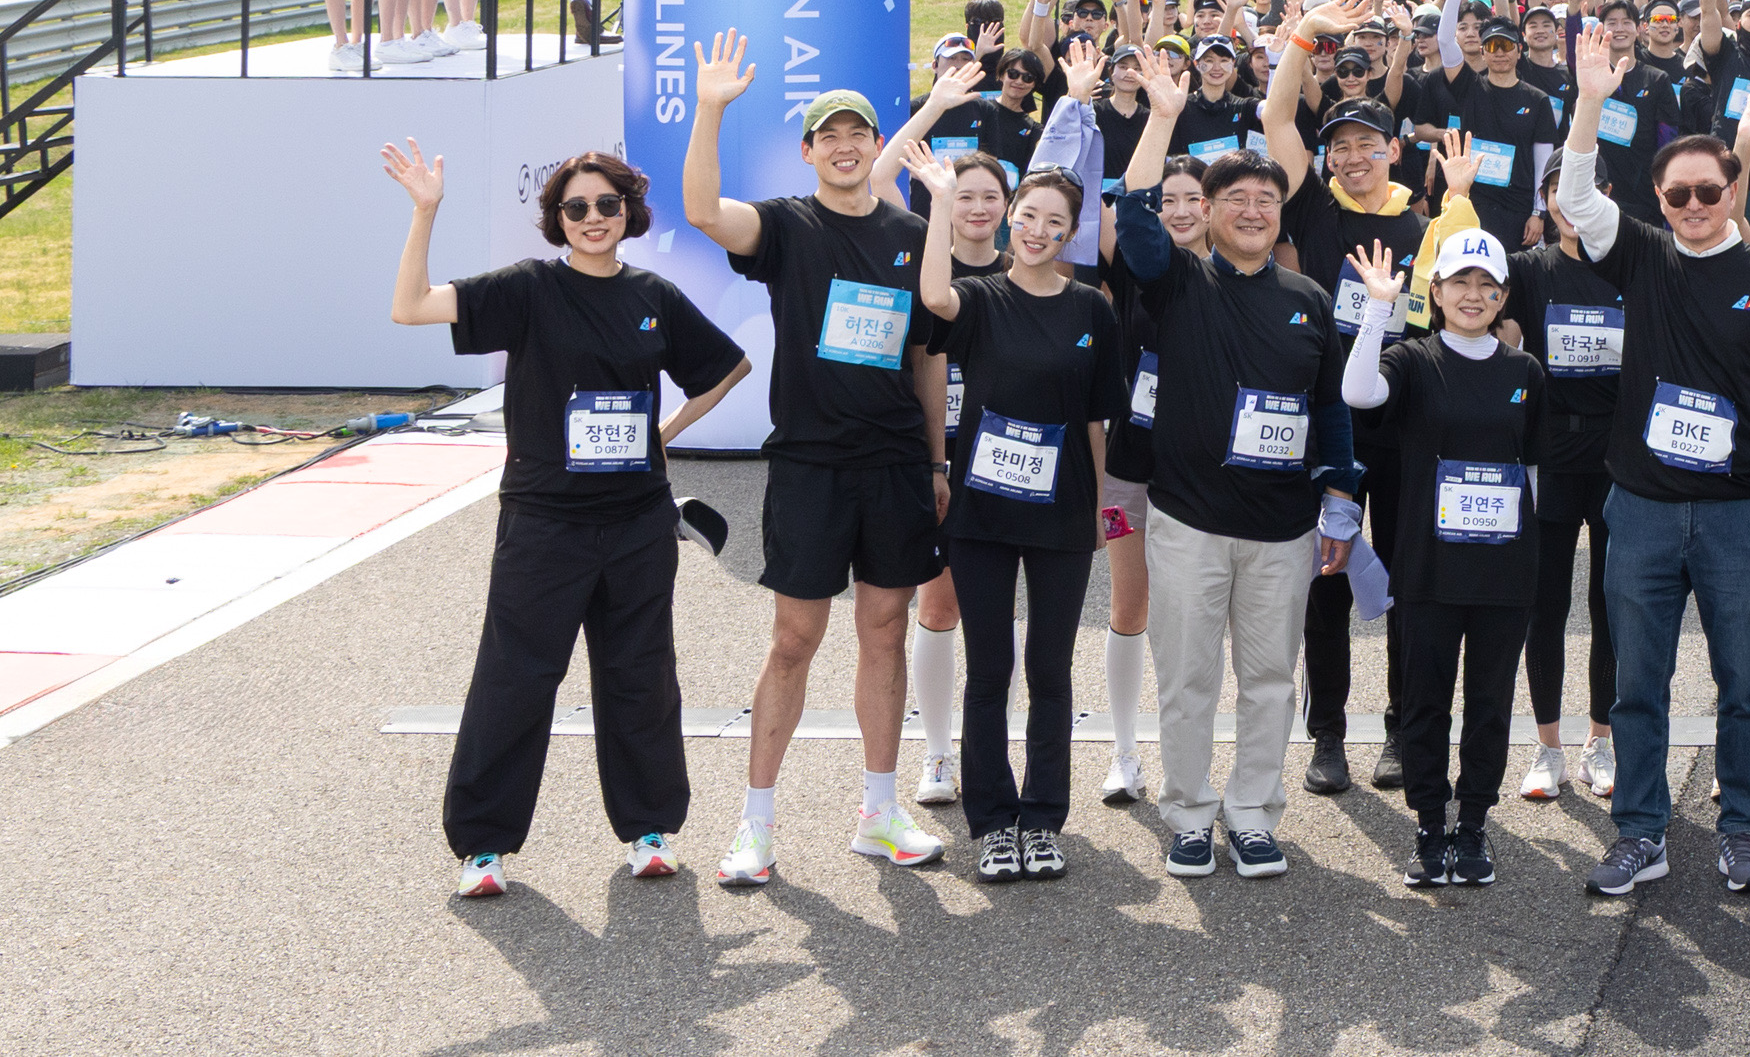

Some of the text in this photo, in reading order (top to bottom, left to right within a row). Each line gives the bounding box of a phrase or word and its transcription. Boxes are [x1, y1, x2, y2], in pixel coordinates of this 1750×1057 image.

[783, 36, 820, 123] AIR
[1462, 238, 1490, 257] LA
[858, 293, 894, 308] WE RUN
[1570, 313, 1604, 324] WE RUN
[845, 316, 894, 339] 허진우
[860, 339, 884, 349] 0206
[1561, 335, 1608, 353] 한국보
[1577, 355, 1600, 363] 0919
[595, 401, 632, 411] WE RUN
[1265, 400, 1300, 413] WE RUN
[1678, 395, 1695, 407] WE
[1695, 399, 1716, 413] RUN
[585, 424, 637, 443] 장현경
[1005, 426, 1021, 438] WE
[1022, 430, 1042, 443] RUN
[1260, 425, 1294, 442] DIO
[1672, 420, 1711, 442] BKE
[595, 446, 629, 454] D 0877
[1259, 445, 1290, 455] B 0232
[1671, 440, 1706, 455] B 0227
[992, 447, 1044, 475] 한미정
[996, 469, 1031, 484] C 0508
[1465, 471, 1502, 483] WE RUN
[1460, 495, 1505, 514] 길연주
[1463, 517, 1498, 527] D 0950
